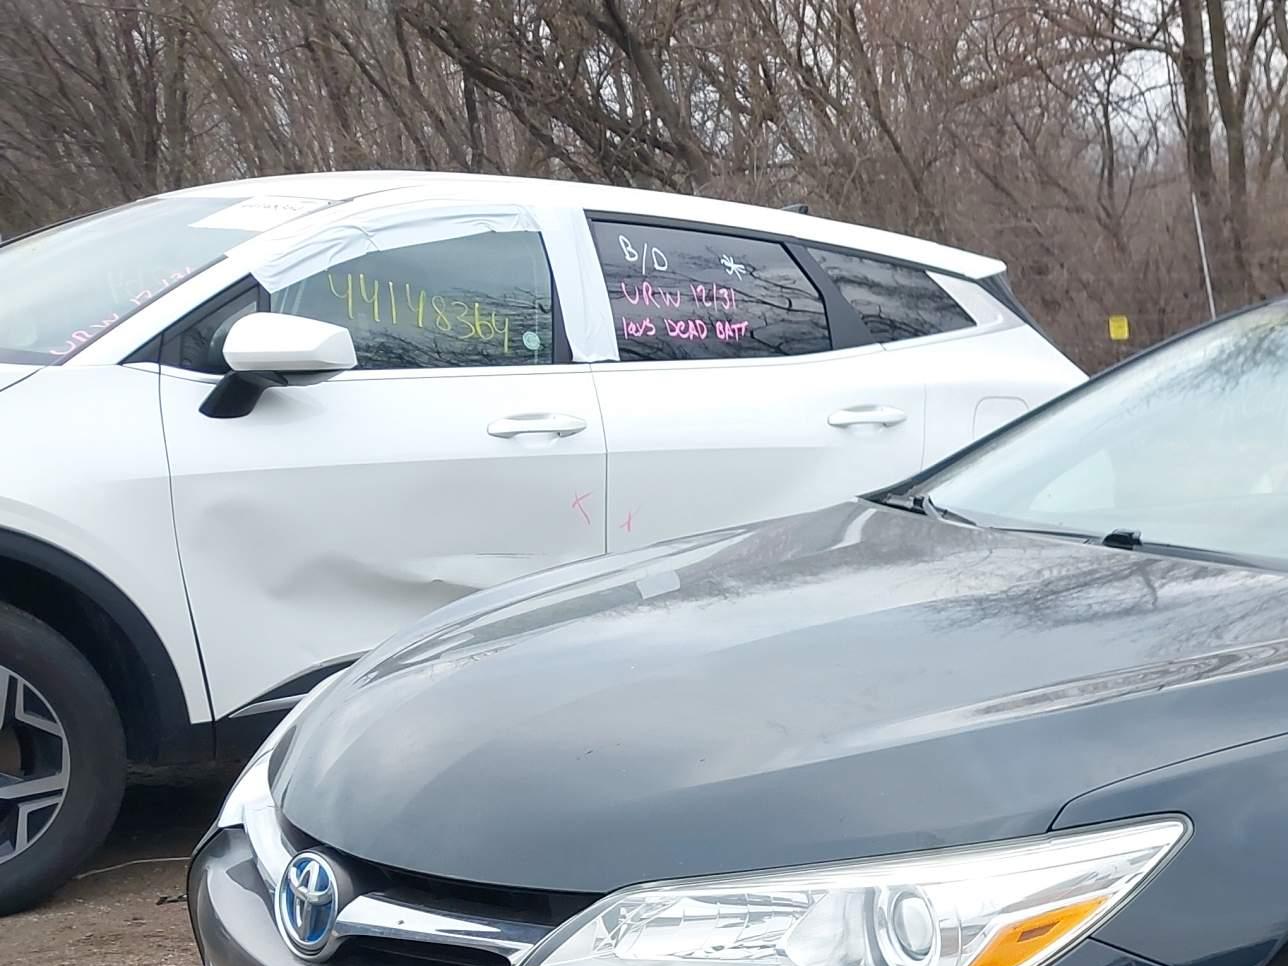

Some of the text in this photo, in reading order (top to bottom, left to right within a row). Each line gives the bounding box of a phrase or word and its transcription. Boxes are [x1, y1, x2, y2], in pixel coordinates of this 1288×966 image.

[618, 234, 669, 275] B/D
[328, 273, 509, 353] 44148364
[689, 283, 737, 313] 12/31
